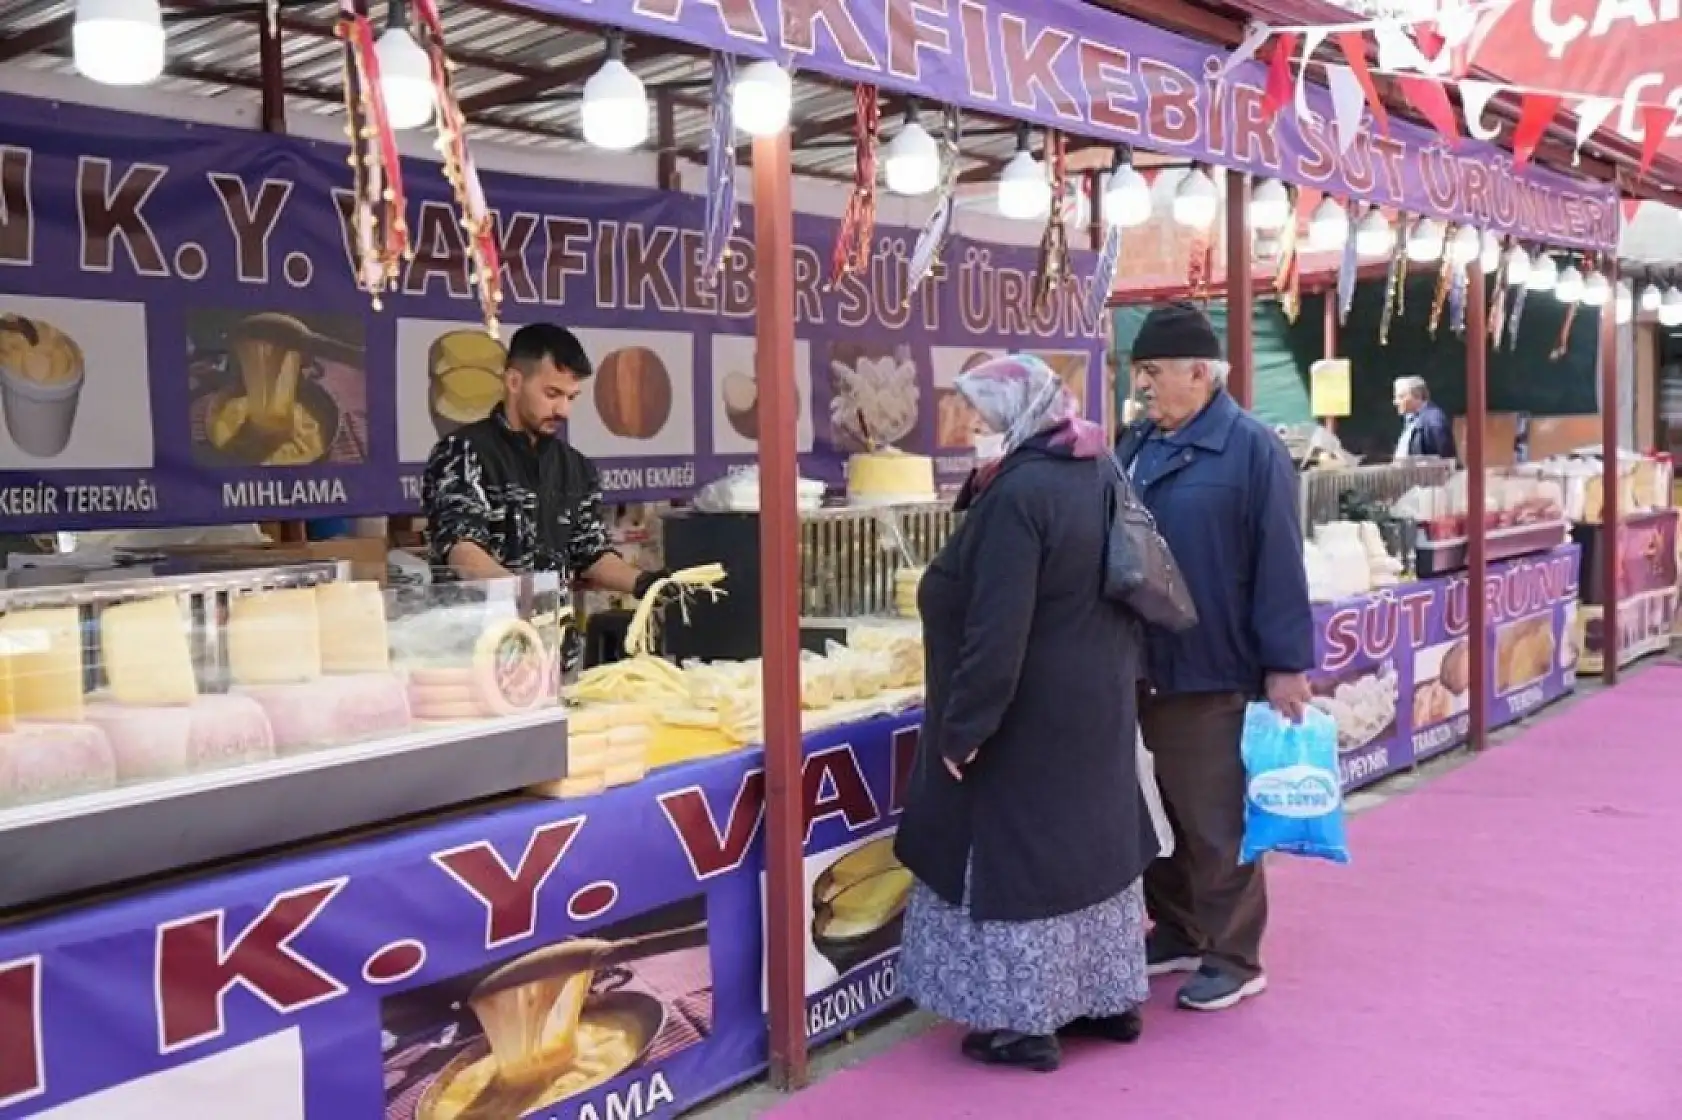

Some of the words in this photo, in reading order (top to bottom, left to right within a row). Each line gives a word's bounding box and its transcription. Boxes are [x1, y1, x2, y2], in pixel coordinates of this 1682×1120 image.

[578, 0, 1282, 170] KFIKEBİR
[332, 187, 825, 325] AKFIKEBR
[958, 246, 1110, 338] ÜRÜN
[65, 478, 157, 513] TEREYAĞI
[222, 478, 348, 508] MIHLAMA
[1322, 588, 1435, 672] SÜT
[869, 960, 900, 1010] KÖ
[550, 1071, 674, 1120] AMA
